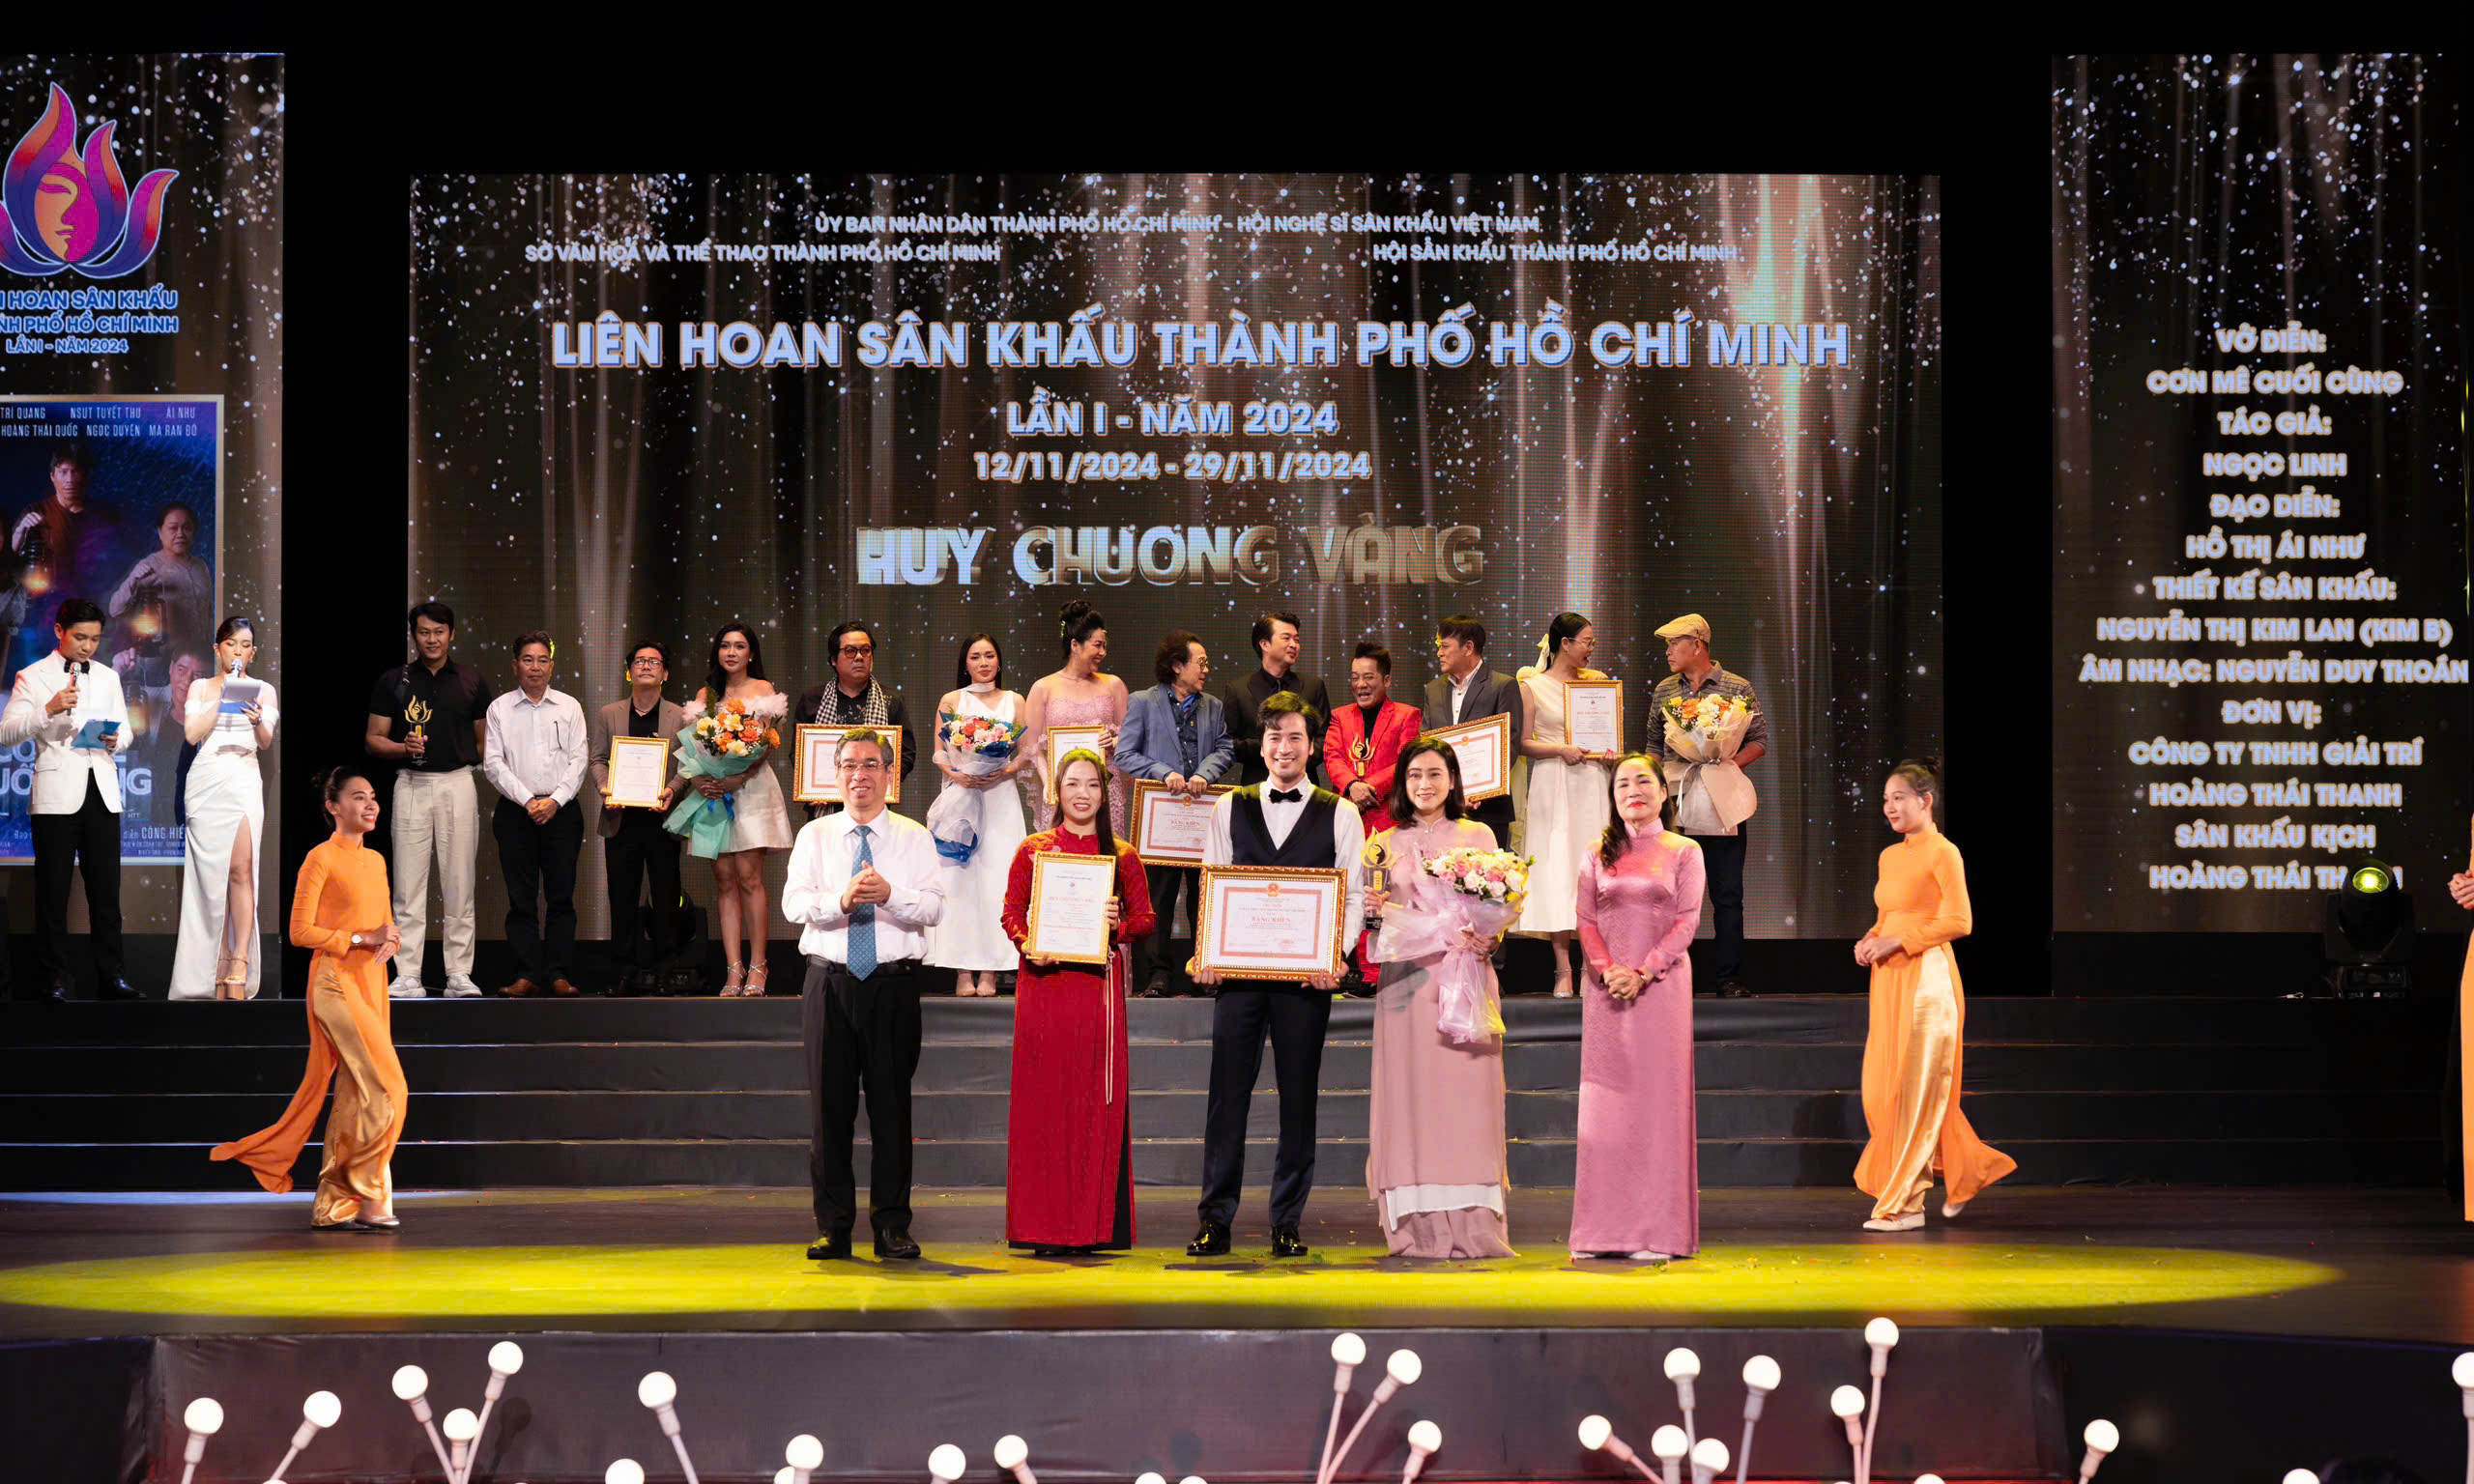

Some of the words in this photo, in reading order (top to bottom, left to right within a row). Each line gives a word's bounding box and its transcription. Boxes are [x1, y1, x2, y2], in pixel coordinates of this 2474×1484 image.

[815, 212, 843, 233] ỦY
[846, 216, 887, 233] BAN
[889, 213, 943, 233] NHÂN
[946, 213, 986, 233] DÂN
[990, 212, 1055, 233] THÀNH
[1059, 210, 1100, 233] PHỐ
[1103, 210, 1131, 233] HỒ
[1132, 212, 1169, 233] CHÍ
[1171, 216, 1218, 233] MINH
[1237, 211, 1271, 236] HỘI
[1330, 212, 1349, 233] SĨ
[1351, 212, 1391, 233] SÂN
[1394, 209, 1448, 233] KHẤU
[1450, 212, 1493, 237] VIỆT
[1496, 216, 1539, 233] NAM
[525, 240, 554, 262] SỞ
[555, 241, 596, 262] VĂN
[643, 240, 671, 262] VÀ
[673, 238, 712, 262] THỂ
[713, 244, 768, 262] THAO
[771, 241, 837, 262] THÀNH
[840, 238, 882, 262] PHỐ
[884, 238, 913, 262] HỒ
[915, 241, 951, 262] CHÍ
[952, 244, 1001, 262] MINH
[1373, 240, 1408, 265] HỘI
[1410, 238, 1450, 261] SÂN
[1453, 238, 1507, 262] KHẤU
[1509, 240, 1575, 262] THÀNH
[1578, 237, 1620, 262] PHỐ
[1622, 238, 1651, 262] HỒ
[1654, 241, 1687, 262] CHÍ
[1689, 244, 1739, 262] MINH
[8, 290, 70, 309] HOAN
[71, 285, 116, 309] SÂN
[118, 283, 178, 309] KHẤU
[23, 310, 64, 333] PHỐ
[66, 310, 94, 333] HỒ
[97, 311, 130, 333] CHÍ
[130, 316, 180, 333] MINH
[552, 309, 663, 368] LIÊN
[679, 321, 843, 368] HOAN
[857, 309, 970, 368] SÂN
[986, 301, 1138, 368] KHẤU
[1152, 307, 1340, 368] THÀNH
[1356, 300, 1477, 368] PHỐ
[1489, 298, 1575, 368] HỒ
[1589, 306, 1696, 368] CHÍ
[1707, 321, 1851, 368] MINH
[2216, 322, 2258, 354] VỞ
[2260, 320, 2327, 354] DIỄN:
[6, 334, 36, 354] LẦN
[37, 338, 44, 354] I
[55, 335, 90, 354] NĂM
[90, 338, 129, 354] 2024
[2145, 366, 2208, 394] CƠN
[2212, 364, 2251, 394] MÊ
[2253, 362, 2321, 394] CUỐI
[2325, 364, 2404, 394] CÙNG
[16, 407, 45, 419] QUANG
[1006, 385, 1084, 437] LẦN
[1093, 401, 1108, 437] I
[1115, 414, 1133, 429] -
[1140, 393, 1234, 437] NĂM
[1242, 400, 1341, 437] 2024
[2217, 406, 2272, 435] TÁC
[2275, 404, 2333, 435] GIẢ:
[973, 450, 1160, 484] 12/11/2024
[1164, 463, 1180, 474] -
[1184, 450, 1373, 483] 29/11/2024
[2202, 453, 2285, 482] NGỌC
[2288, 453, 2348, 477] LINH
[2209, 494, 2271, 523] ĐẠO
[2274, 485, 2341, 518] DIỄN:
[855, 526, 996, 586] HUY
[1012, 523, 1280, 586] CHƯƠNG
[1301, 512, 1483, 586] VÀNG
[2230, 535, 2272, 564] THỊ
[2275, 529, 2306, 559] ÁI
[2309, 532, 2368, 559] NHƯ
[2152, 568, 2221, 601] THIẾT
[2223, 568, 2260, 601] KẾ
[2258, 571, 2313, 601] SÂN
[2317, 568, 2398, 601] KHẤU:
[2096, 609, 2201, 642] NGUYỄN
[2204, 618, 2247, 647] THỊ
[2251, 618, 2300, 642] KIM
[2304, 618, 2355, 642] LAN
[2358, 618, 2420, 648] (KIM
[2423, 618, 2454, 648] B)
[2079, 653, 2123, 683] ÂM
[2126, 659, 2212, 688] NHẠC:
[2216, 650, 2320, 683] NGUYỄN
[2324, 659, 2378, 683] DUY
[2221, 698, 2282, 725] ĐƠN
[2286, 700, 2322, 729] VỊ:
[2128, 736, 2211, 766] CÔNG
[2214, 742, 2246, 766] TY
[2248, 742, 2319, 766] TNHH
[2322, 734, 2380, 766] GIẢI
[2383, 736, 2425, 766] TRÍ
[2148, 777, 2248, 807] HOÀNG
[2251, 777, 2311, 807] THÁI
[2314, 784, 2402, 807] THANH
[2175, 818, 2229, 848] SÂN
[2233, 814, 2307, 848] KHẤU
[2311, 825, 2376, 854] KỊCH
[2148, 860, 2248, 890] HOÀNG
[2251, 860, 2311, 890] THÁI
